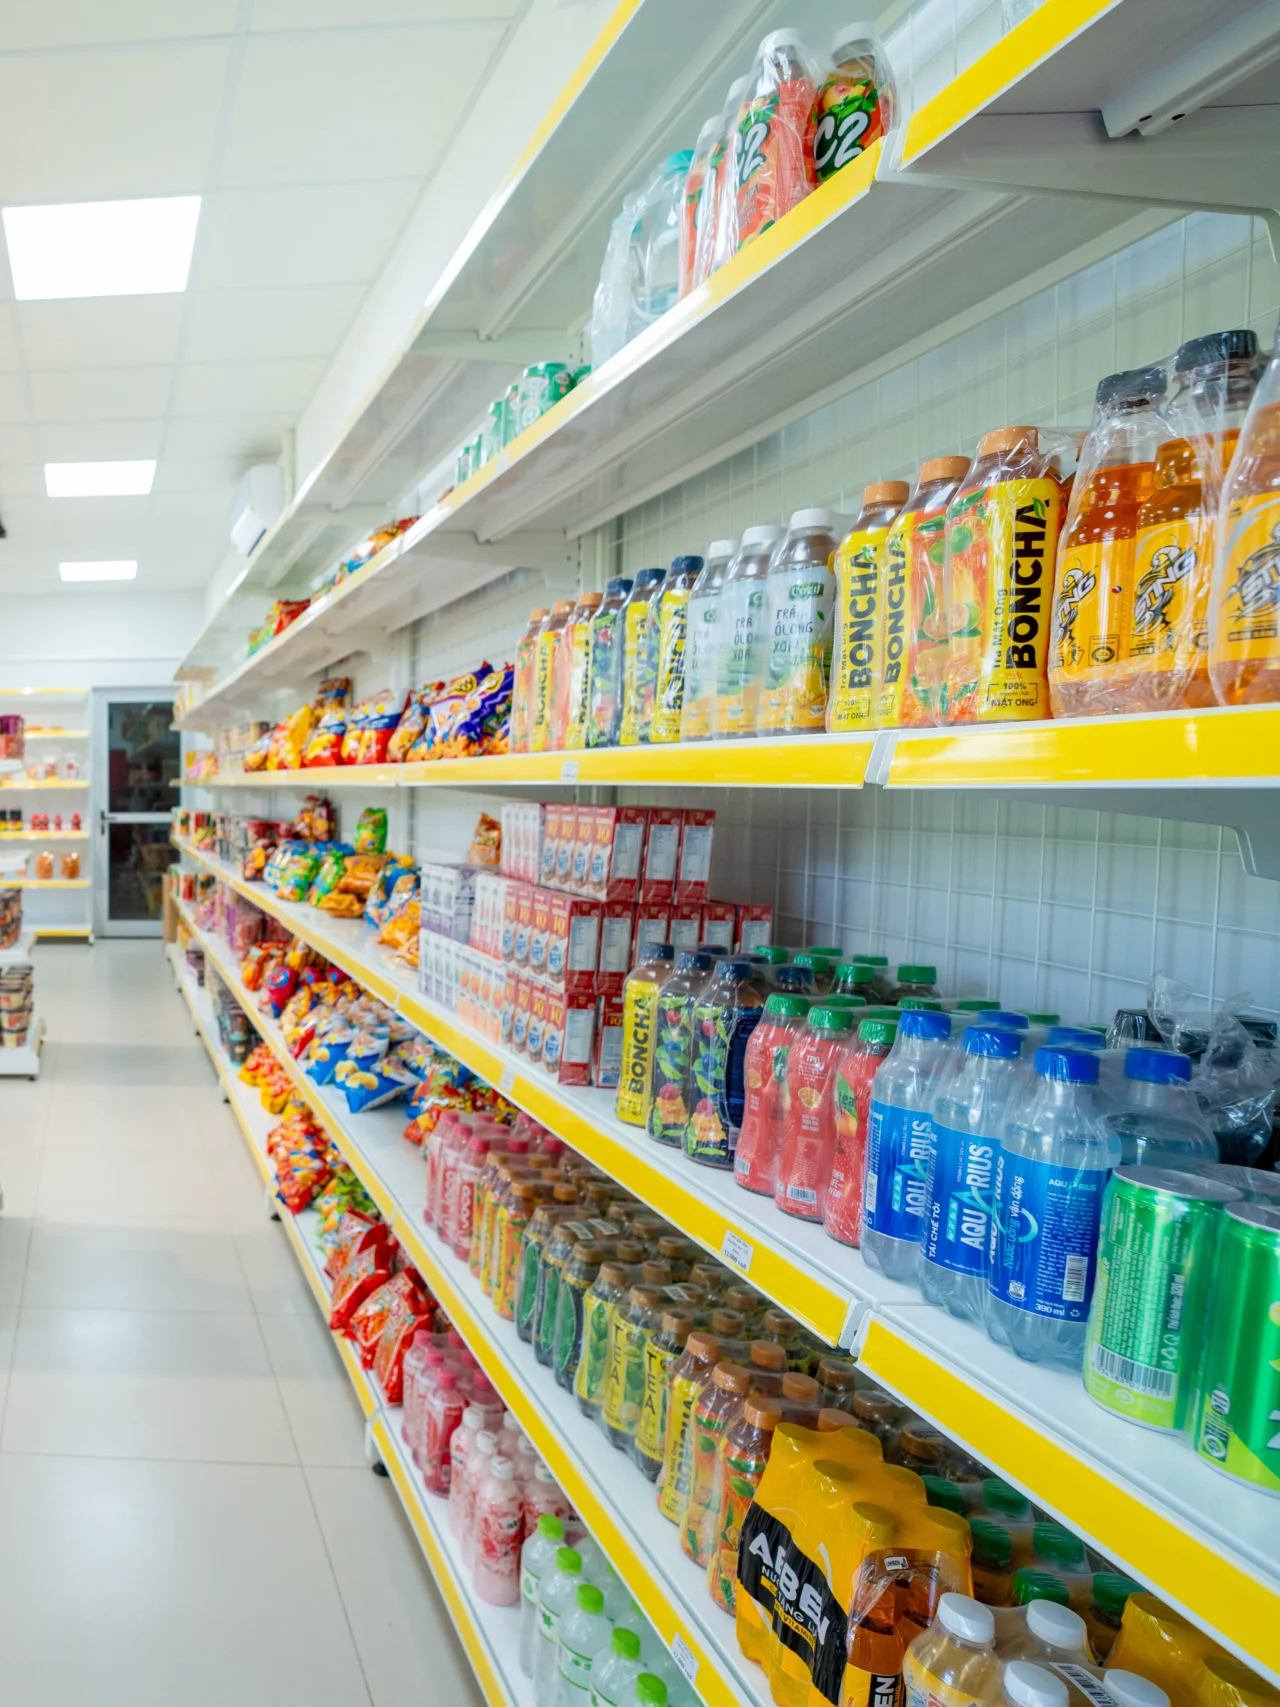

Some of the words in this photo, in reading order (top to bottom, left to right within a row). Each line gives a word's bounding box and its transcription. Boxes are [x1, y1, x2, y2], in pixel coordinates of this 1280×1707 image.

[813, 111, 869, 169] C2
[884, 533, 906, 684] BONCHA
[995, 589, 1008, 616] Ong
[1006, 498, 1050, 670] BONCHA
[1134, 550, 1197, 623] STING
[847, 545, 878, 690] BONCHA
[1003, 682, 1027, 691] 100%
[1015, 698, 1035, 708] ONG
[628, 996, 652, 1094] BONCHA
[951, 1144, 994, 1251] AQUARIUS
[1048, 1178, 1097, 1192] AQUARIUS
[1035, 1303, 1052, 1314] 390
[610, 1323, 625, 1386] TEA
[645, 1350, 657, 1415] TEA
